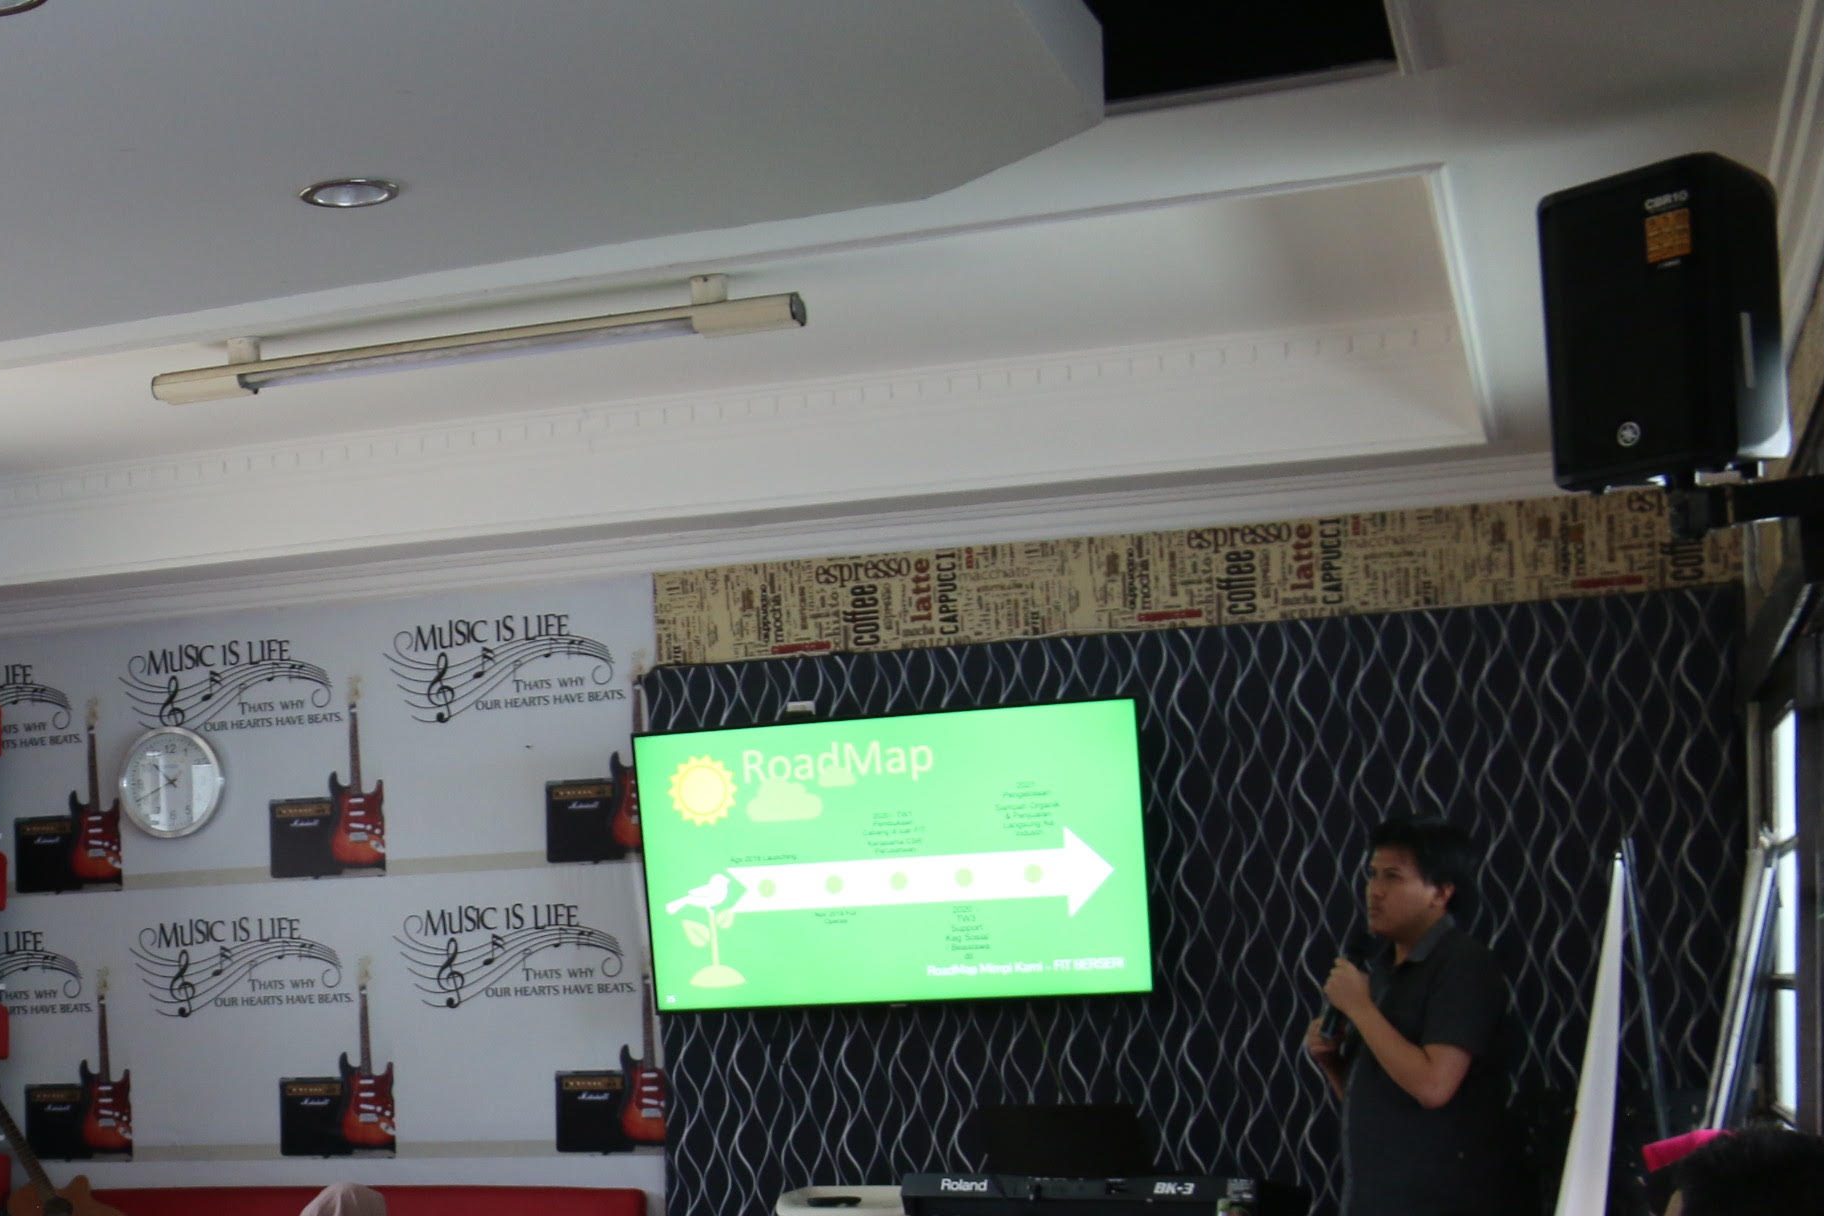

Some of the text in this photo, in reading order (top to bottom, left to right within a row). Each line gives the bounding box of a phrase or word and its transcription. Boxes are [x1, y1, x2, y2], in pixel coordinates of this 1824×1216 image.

[1187, 522, 1292, 553] espresso
[1290, 523, 1315, 591] latte
[1319, 518, 1344, 605] CAPPUCCI
[815, 556, 911, 587] espresso
[1216, 549, 1257, 615] coffee
[911, 558, 933, 622] latte
[936, 553, 959, 635] CAPPUCCI
[843, 583, 880, 647] coffee
[496, 615, 515, 641] IS
[523, 613, 570, 640] LIFE
[222, 640, 241, 666] IS
[247, 639, 291, 665] LIFE
[513, 676, 585, 693] THATS WHY
[238, 699, 305, 716] THATS WHY
[475, 699, 502, 711] OUR
[504, 696, 550, 709] HEARTS
[553, 693, 584, 705] HAVE
[1, 721, 48, 734] ATS WHY
[204, 720, 228, 732] OUR
[231, 718, 273, 730] HEARTS
[276, 715, 305, 727] HAVE
[20, 737, 46, 748] HAVE
[742, 741, 934, 783] RoadMap
[505, 903, 524, 930] IS
[532, 903, 580, 929] LIFE
[232, 916, 250, 942] IS
[258, 917, 302, 942] LIFE
[4, 930, 44, 954] LIFE
[523, 967, 594, 981] THATS WHY
[35, 989, 58, 1000] WHY
[248, 978, 316, 993] THATS WHY
[485, 987, 511, 998] OUR
[514, 985, 559, 997] HEARTS
[562, 983, 593, 995] HAVE
[30, 1004, 57, 1014] HAVE
[214, 996, 239, 1008] OUR
[241, 995, 285, 1007] HEARTS
[286, 994, 315, 1005] HAVE
[940, 1178, 988, 1193] Roland
[1153, 1181, 1196, 1195] BK-3
